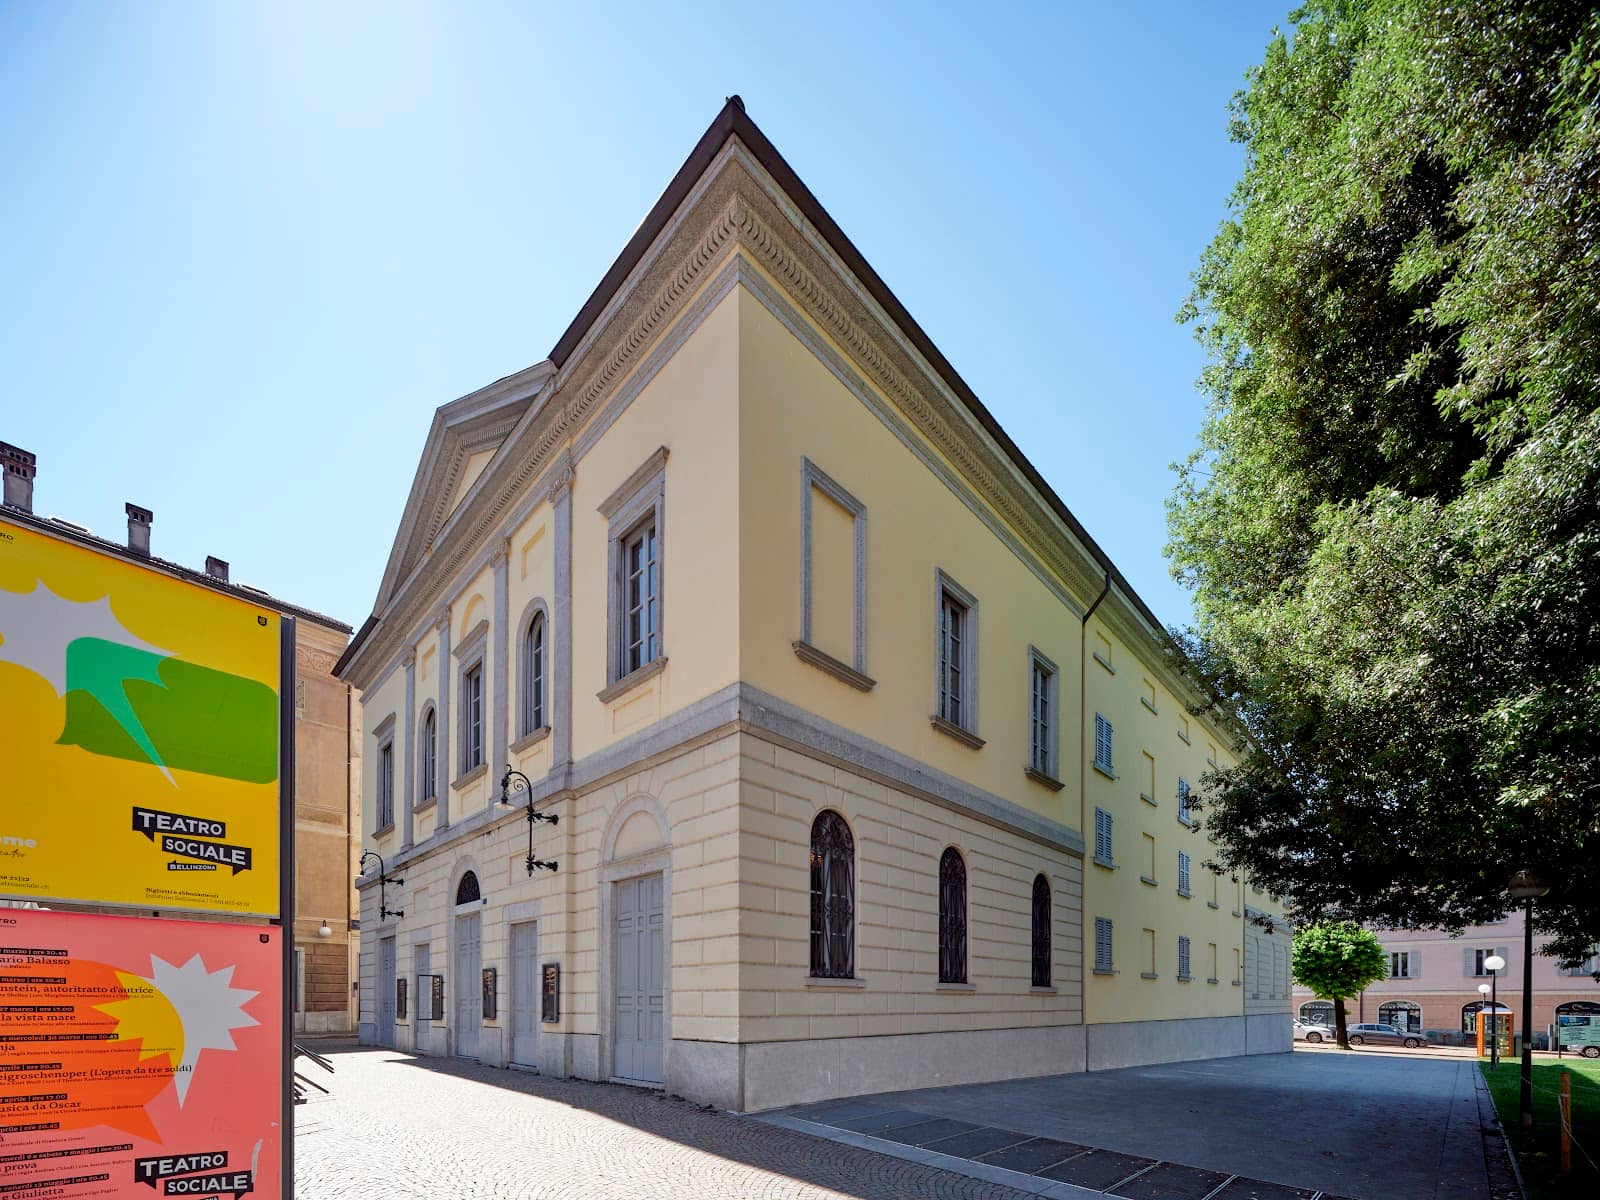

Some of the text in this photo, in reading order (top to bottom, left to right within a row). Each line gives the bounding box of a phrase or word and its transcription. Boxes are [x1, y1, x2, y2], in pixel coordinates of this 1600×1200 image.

[137, 811, 222, 836] TEATRO
[165, 838, 246, 866] SOCIALE
[27, 956, 71, 965] Balasso
[43, 985, 108, 993] autoritratto
[110, 985, 154, 994] d'autrice
[1, 1013, 12, 1021] la
[134, 1066, 143, 1074] da
[165, 1064, 192, 1073] soldi)
[32, 1102, 46, 1110] da
[49, 1101, 81, 1109] Oscar
[4, 1161, 37, 1173] prova
[139, 1154, 225, 1177] TEATRO
[167, 1174, 249, 1194] SOCIALE
[11, 1188, 65, 1200] Giulietta
